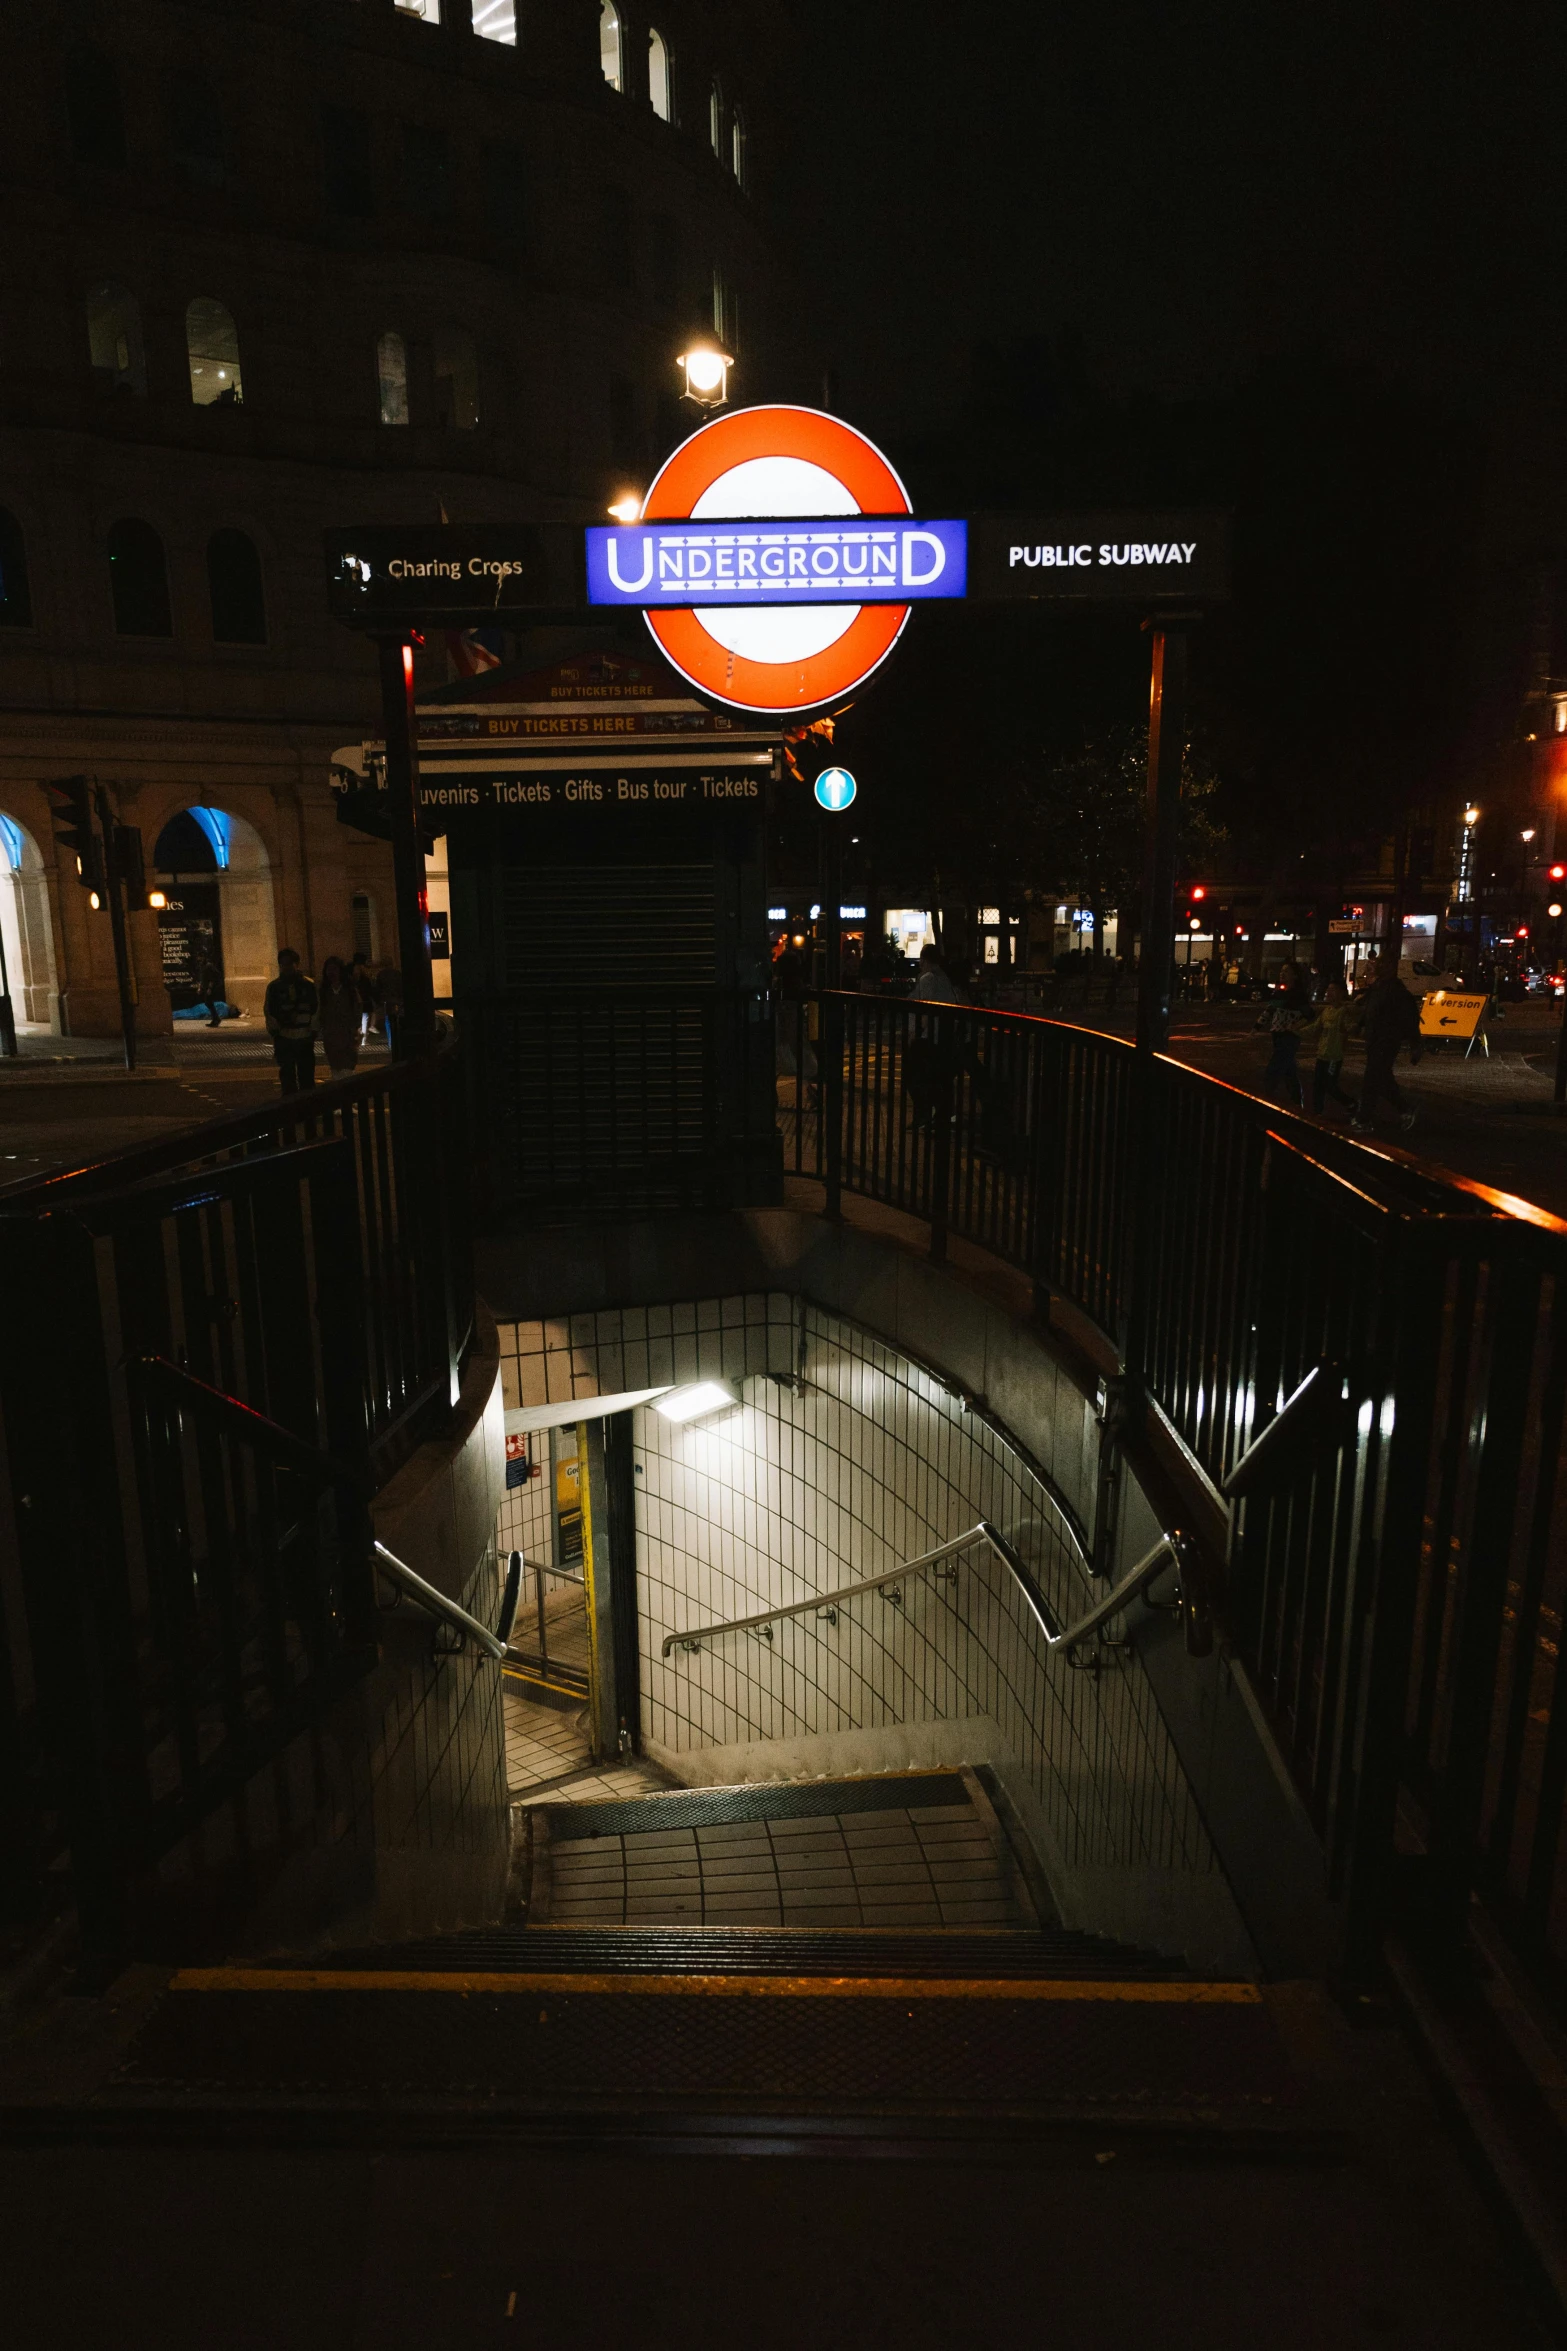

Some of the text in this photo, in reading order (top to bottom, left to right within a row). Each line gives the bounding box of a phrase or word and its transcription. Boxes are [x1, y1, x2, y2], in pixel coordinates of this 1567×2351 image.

[607, 531, 946, 593] UNDERGROUND
[1009, 543, 1197, 567] PUBLIC SUBWAY
[388, 557, 523, 580] Charing Cross
[551, 685, 655, 697] BUY TICKETS HERE
[488, 719, 519, 734] BUY
[524, 718, 589, 733] TICKETS
[594, 717, 635, 731] HERE
[493, 781, 551, 803] Tickets
[565, 779, 603, 801] Gifts
[617, 778, 649, 799] Bus
[653, 779, 687, 799] tour
[700, 776, 758, 797] Tickets
[431, 928, 444, 939] W
